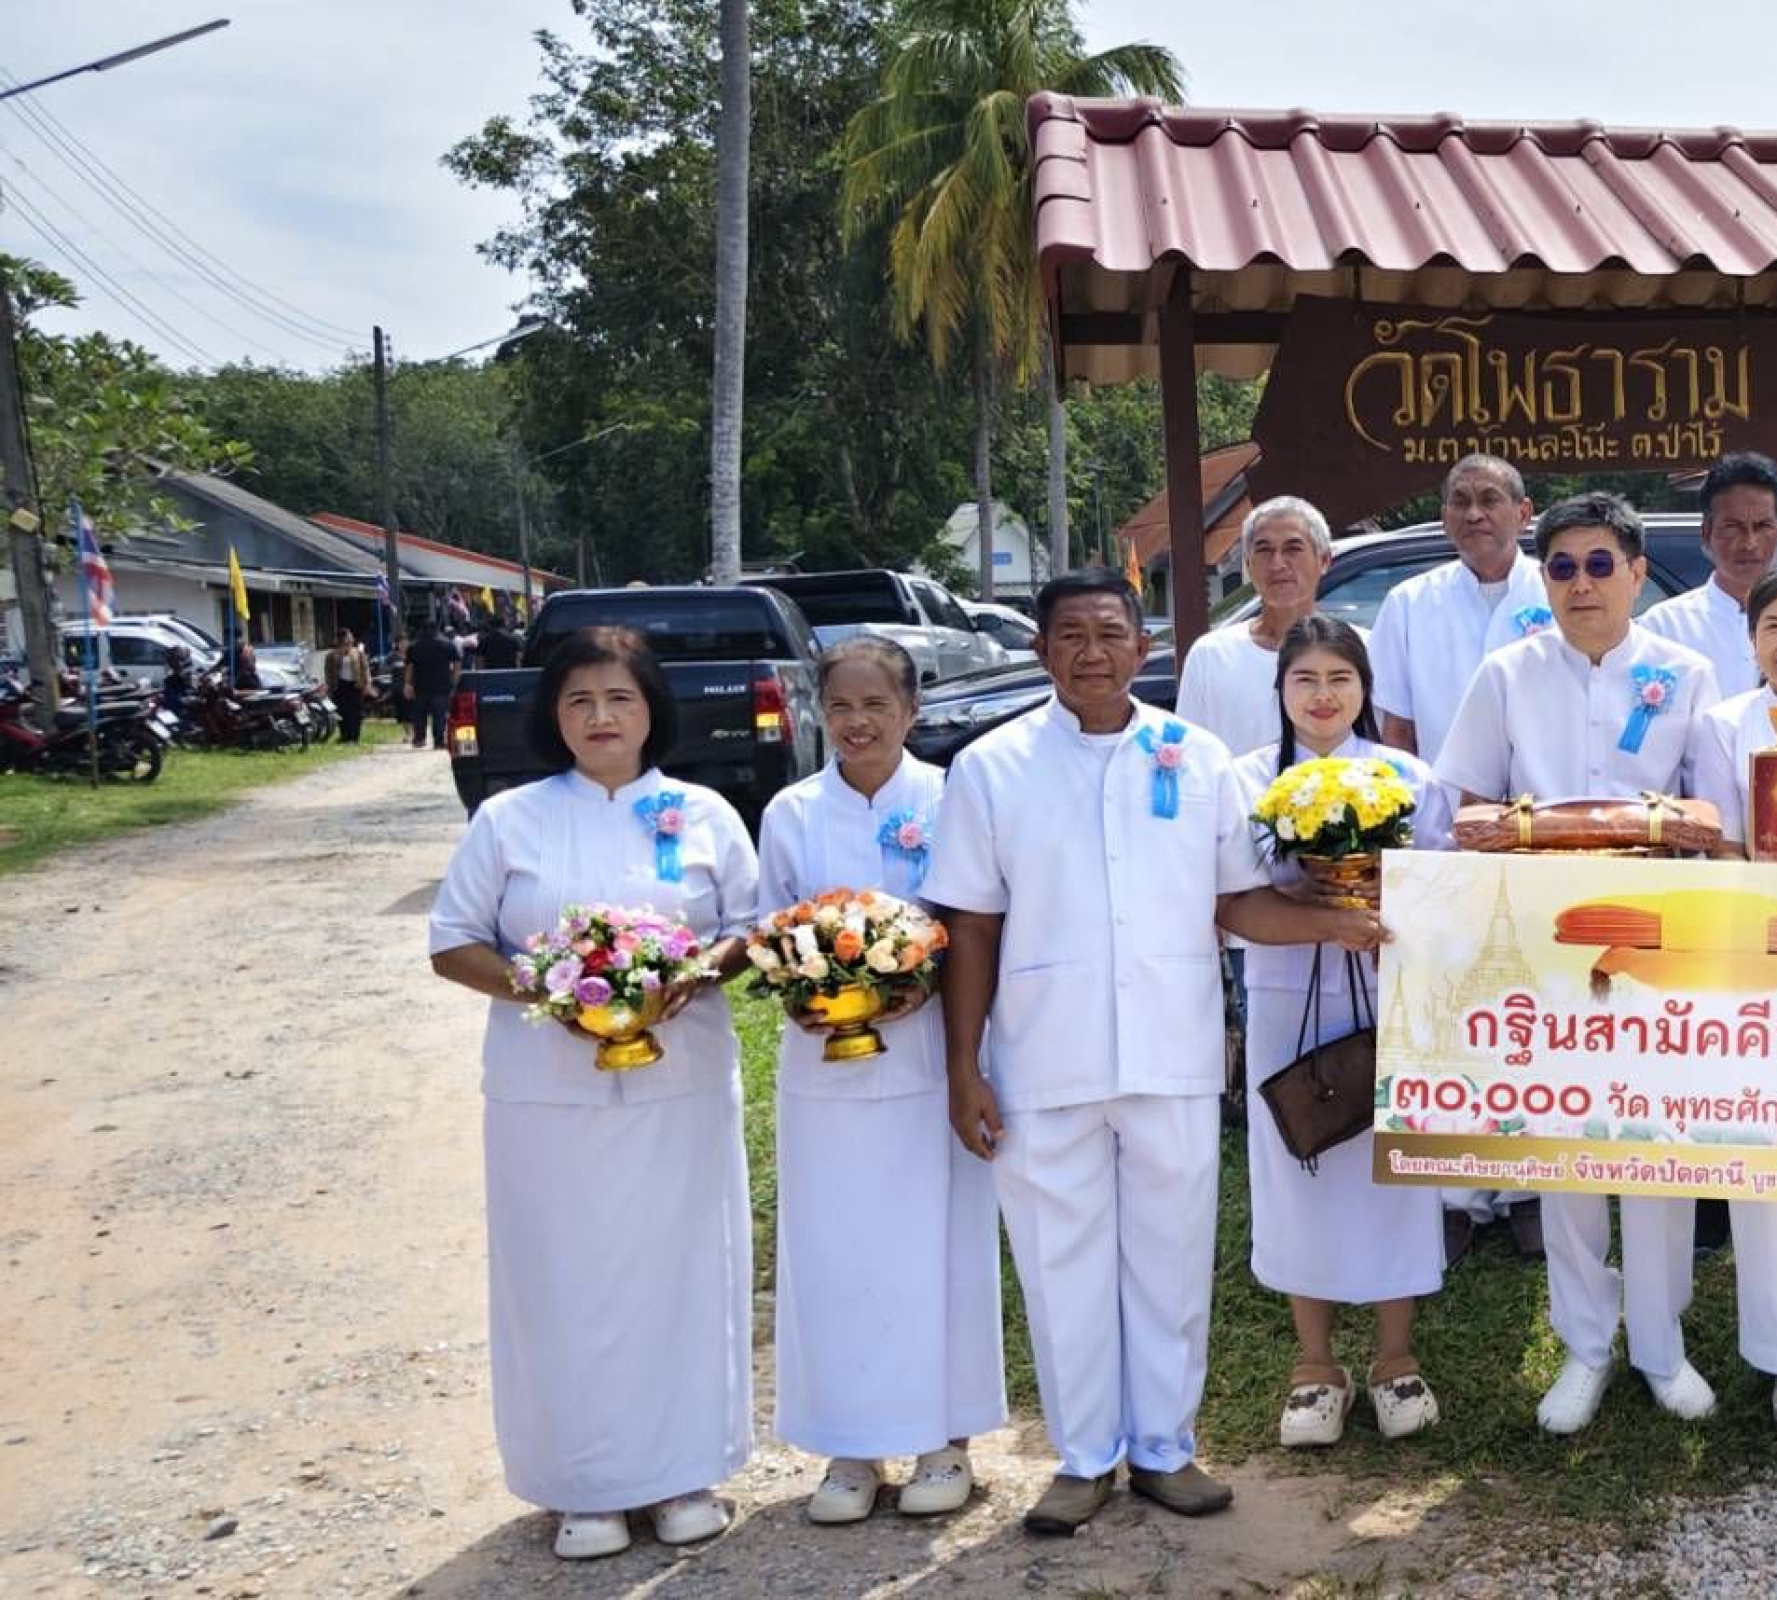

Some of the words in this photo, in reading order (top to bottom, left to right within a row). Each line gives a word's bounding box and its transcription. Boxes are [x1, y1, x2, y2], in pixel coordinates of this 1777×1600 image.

[1345, 313, 1753, 452] วัดโพธาราม
[1395, 1077, 1593, 1119] ๓๐,๐๐๐
[1607, 1081, 1651, 1119] วัด
[1573, 1154, 1746, 1187] จังหวัดปัตตานี
